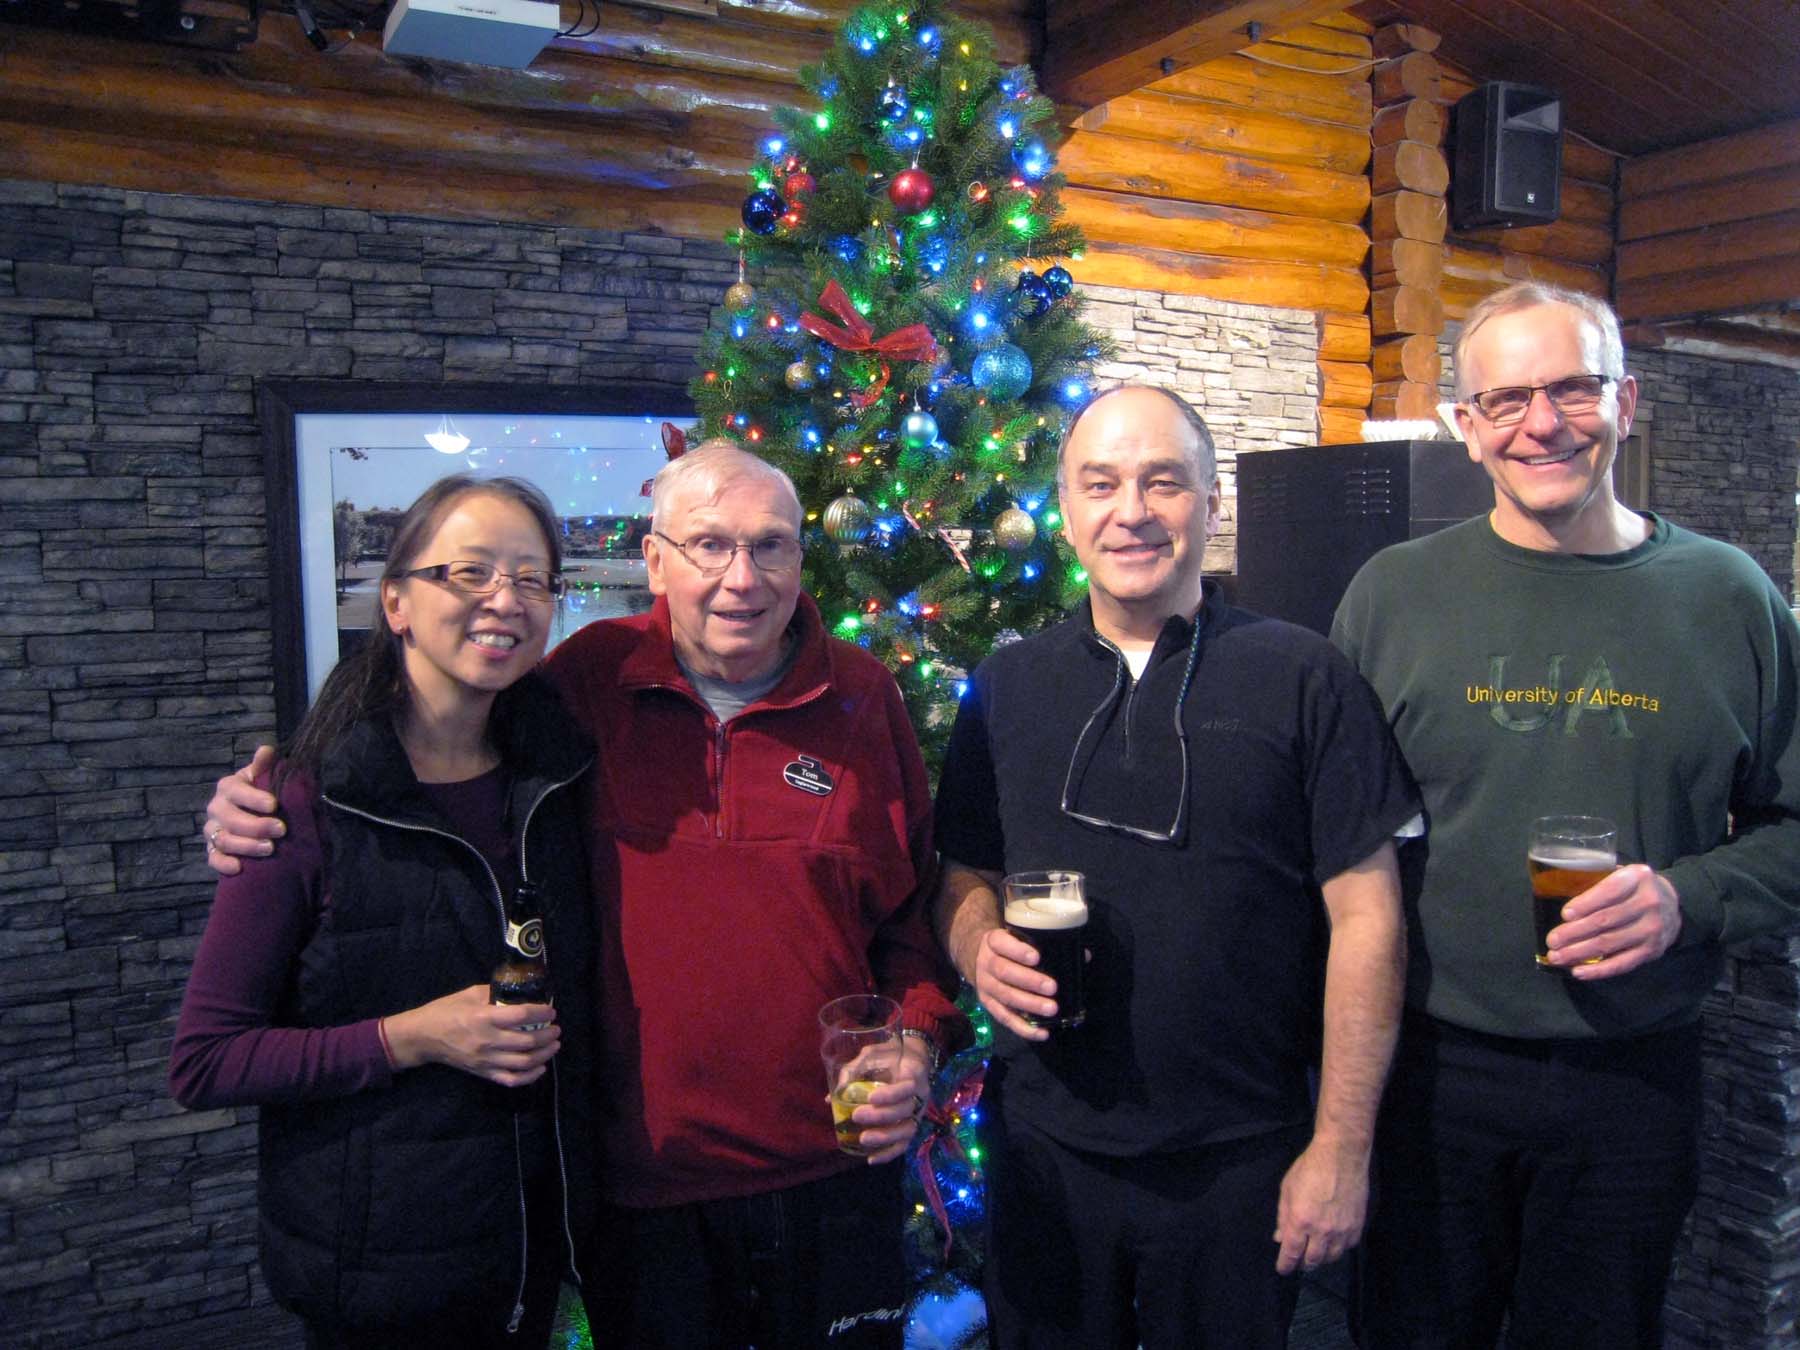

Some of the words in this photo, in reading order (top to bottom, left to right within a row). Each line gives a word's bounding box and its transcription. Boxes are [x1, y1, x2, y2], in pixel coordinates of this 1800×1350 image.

[1466, 685, 1558, 705] University
[1564, 687, 1585, 704] of
[1588, 688, 1659, 713] Alberta
[1488, 654, 1634, 738] UA
[801, 768, 818, 781] Tom
